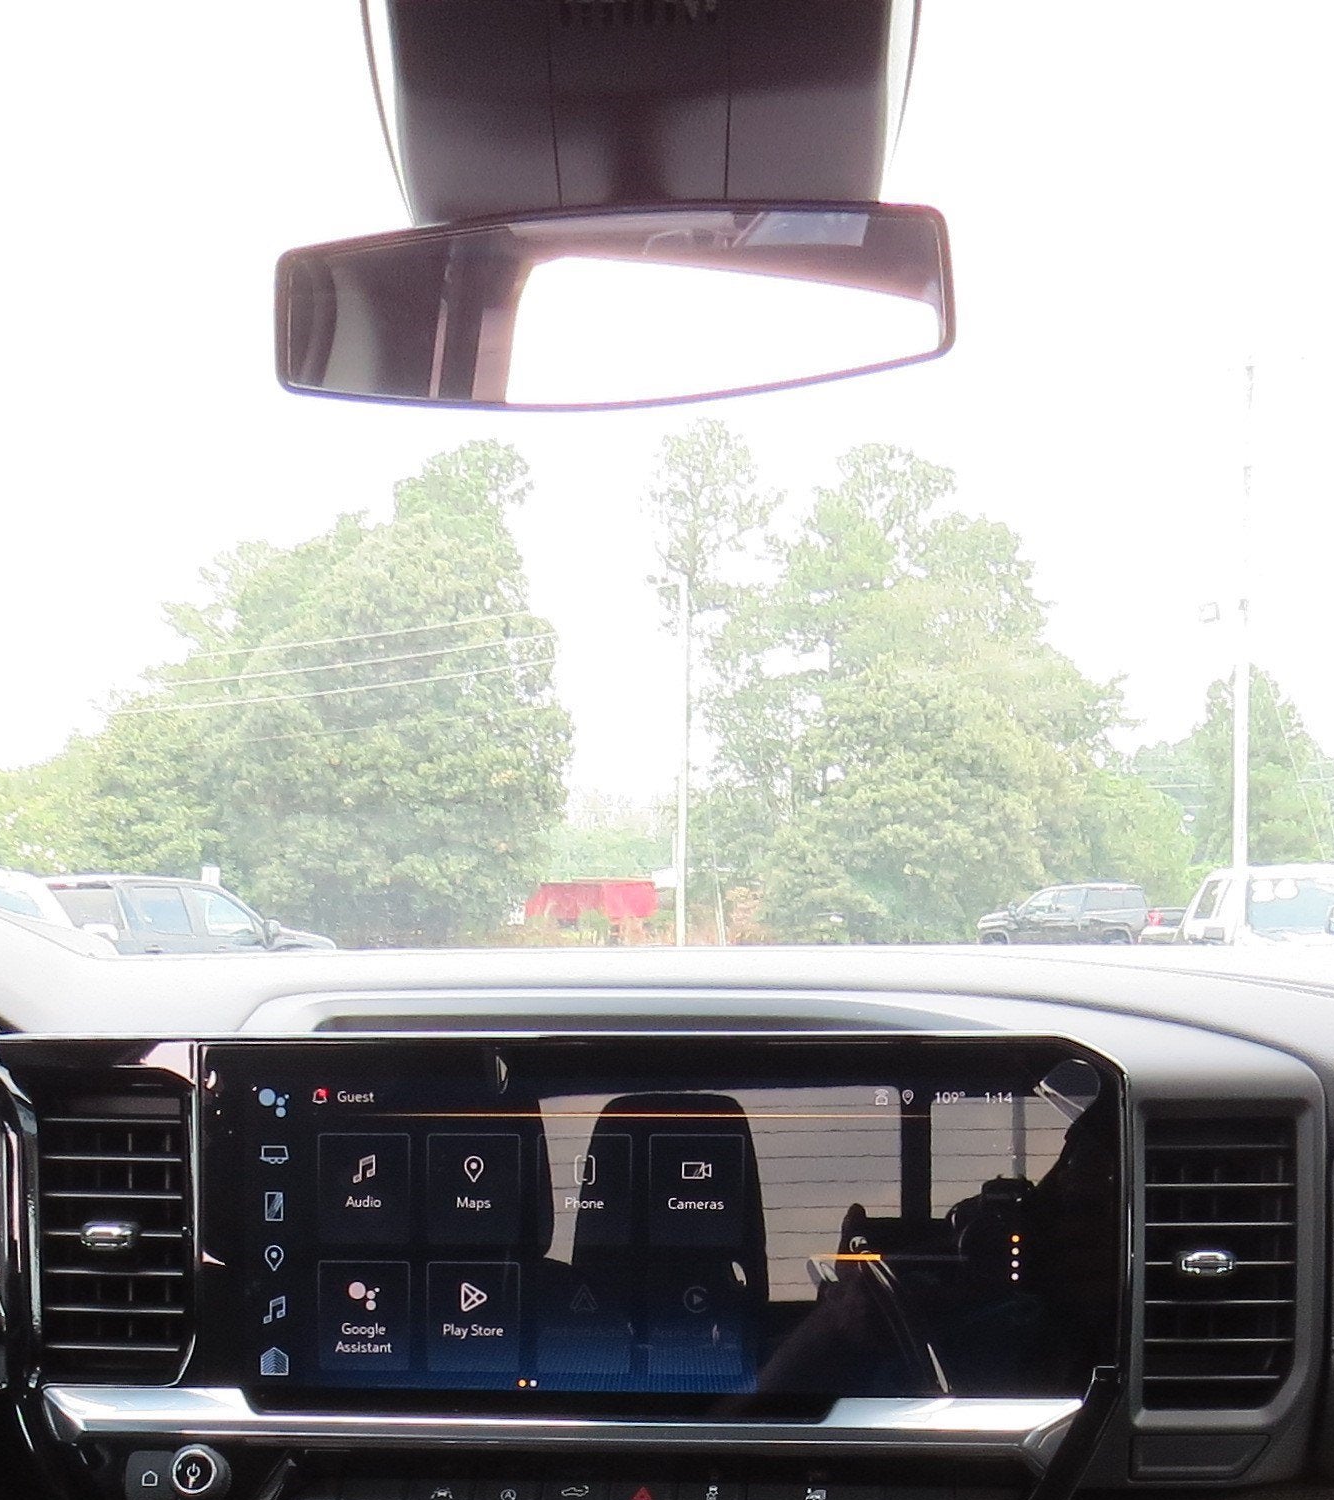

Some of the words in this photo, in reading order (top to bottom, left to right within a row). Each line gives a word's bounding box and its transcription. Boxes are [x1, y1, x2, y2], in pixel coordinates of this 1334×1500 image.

[337, 1090, 374, 1104] Guest
[985, 1092, 1013, 1104] 1:14
[345, 1196, 381, 1209] Audio
[456, 1197, 491, 1211] Maps
[565, 1197, 604, 1210] Phone
[667, 1197, 724, 1210] Cameras
[341, 1323, 386, 1338] Google
[442, 1324, 467, 1338] Play
[470, 1324, 504, 1337] Store
[335, 1341, 392, 1354] Assistant
